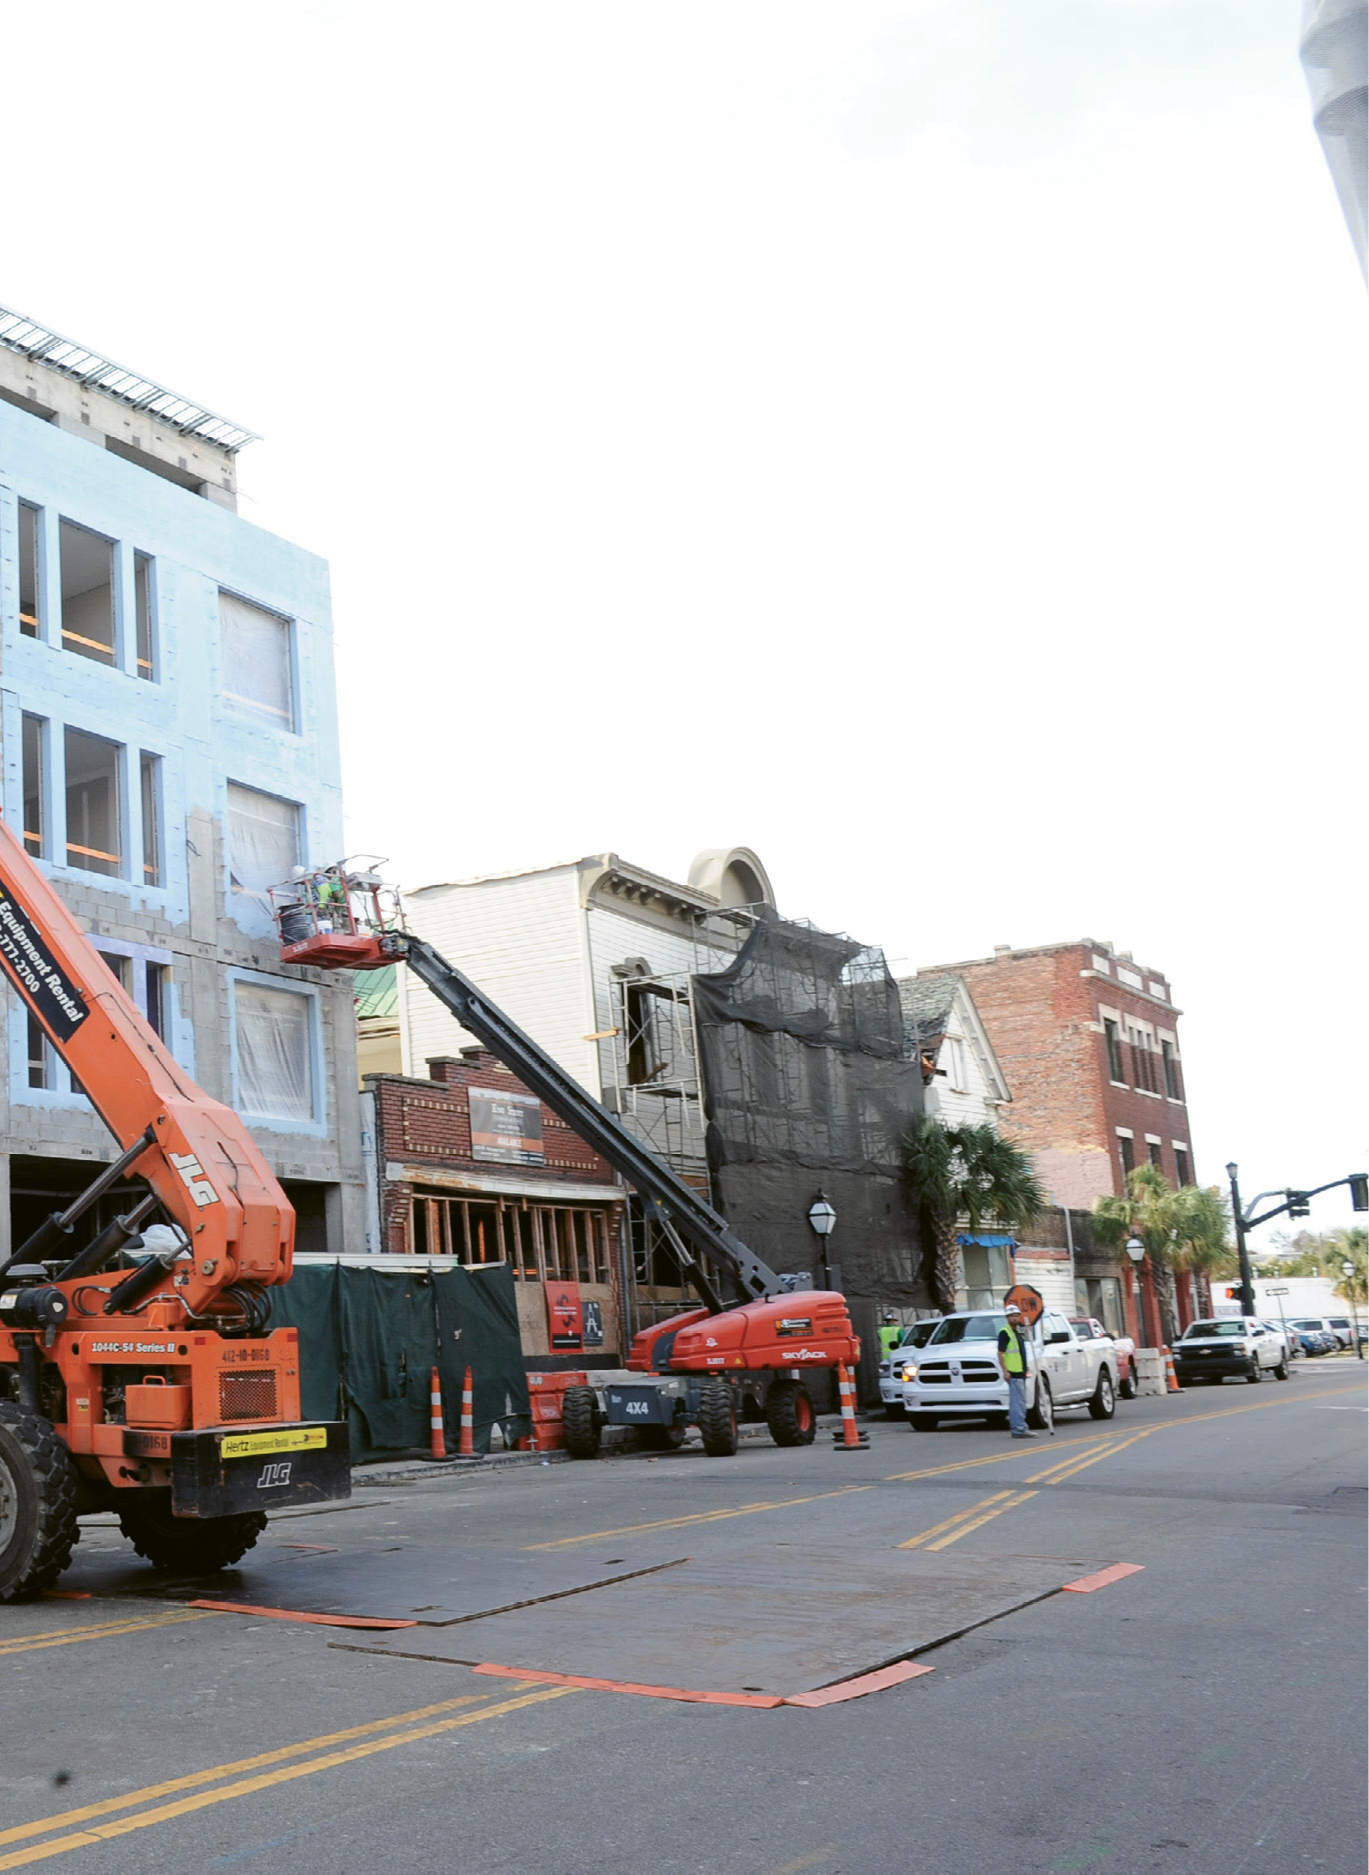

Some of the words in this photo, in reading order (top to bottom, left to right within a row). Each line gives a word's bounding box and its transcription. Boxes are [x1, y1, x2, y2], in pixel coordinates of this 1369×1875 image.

[44, 971, 85, 1023] Rental
[168, 1152, 221, 1207] JLG
[136, 1342, 165, 1353] Series
[167, 1342, 175, 1353] II
[781, 1348, 827, 1360] SKYJACK
[625, 1401, 649, 1415] 4X4
[225, 1440, 249, 1454] Hertz
[256, 1462, 292, 1489] JLG
